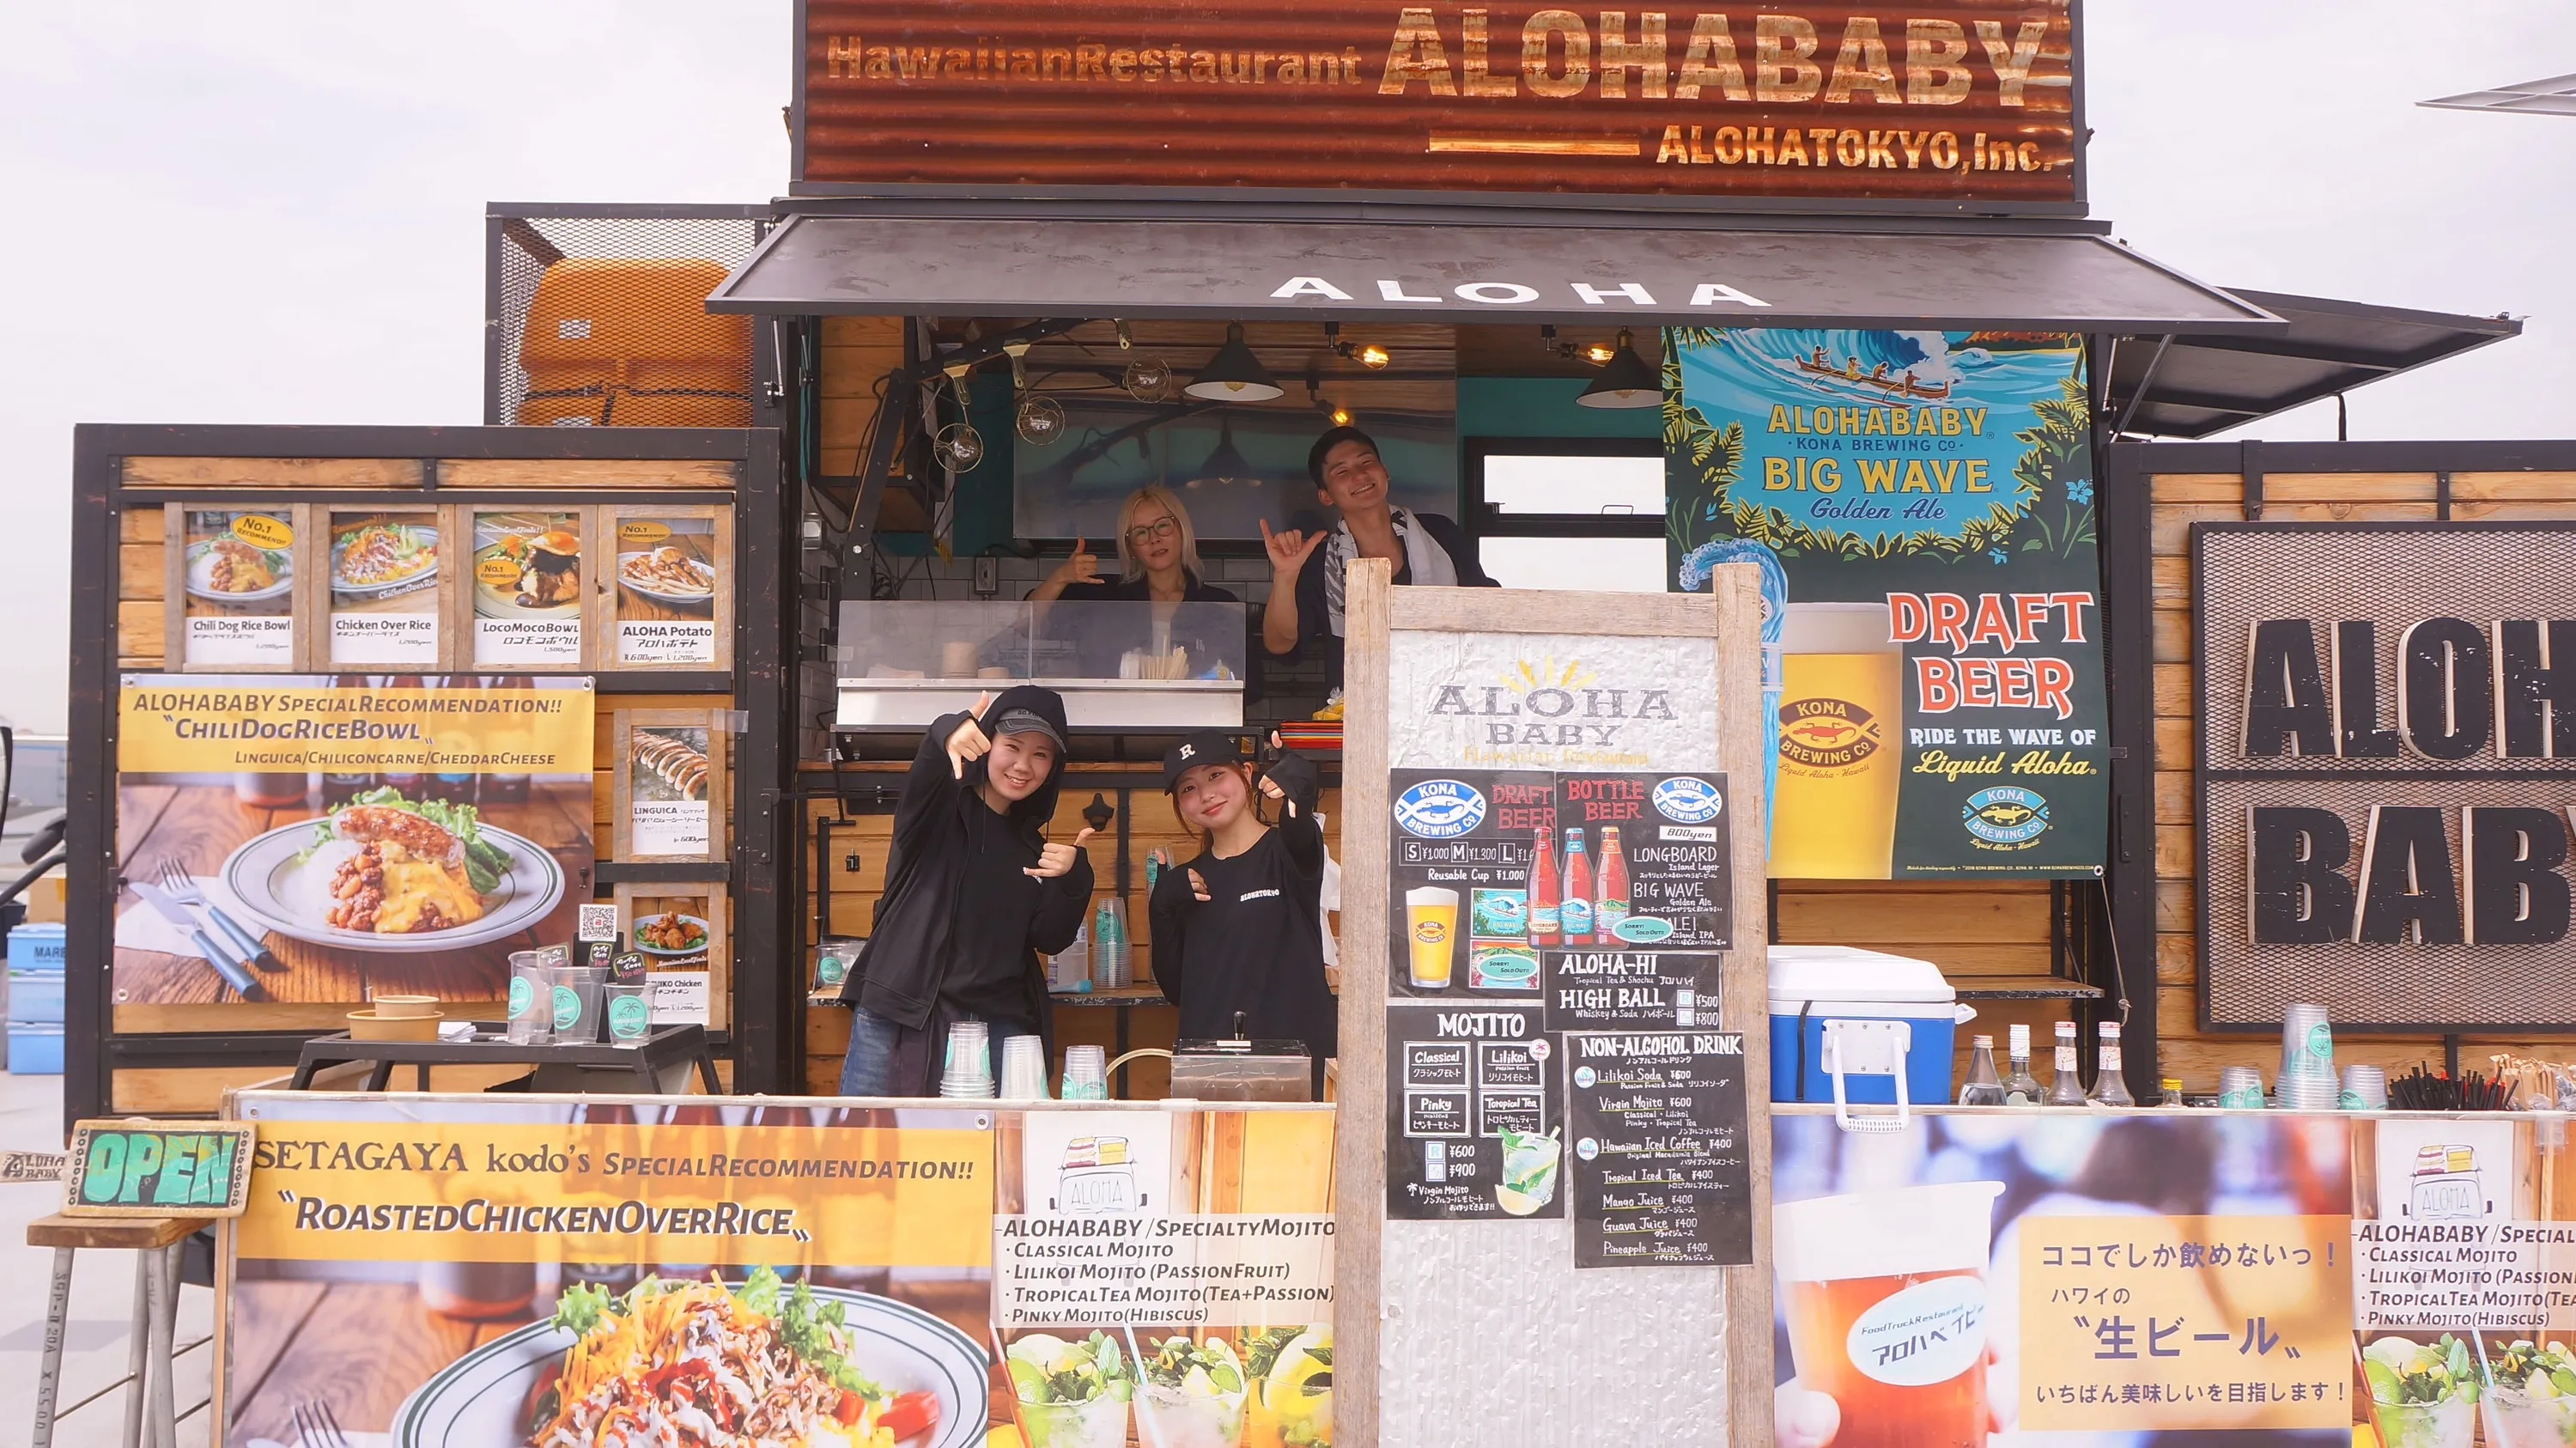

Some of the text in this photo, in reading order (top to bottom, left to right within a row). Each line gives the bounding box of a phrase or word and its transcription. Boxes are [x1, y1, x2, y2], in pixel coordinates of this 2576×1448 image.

[828, 7, 2049, 107] HawaiianRestaurant ALOHABABY
[1269, 277, 1772, 307] ALOHA
[1766, 404, 1988, 437] ALOHABABY
[1796, 437, 1931, 453] KONA BREWING
[1762, 456, 1993, 495] BIG WAVE
[1810, 496, 1947, 520] Golden Ale
[193, 620, 290, 632] Chili Dog Rice Bowl
[336, 619, 431, 630] Chicken Over Rice
[623, 626, 712, 636] ALOHA Potato
[1886, 591, 2096, 656] DRAFT
[1911, 656, 2075, 721] BEER
[133, 694, 274, 712] ALOHABABY
[1428, 684, 1679, 721] ALOHA
[1795, 701, 1847, 717] KONA
[1485, 722, 1622, 746] BABY
[1910, 727, 2097, 748] RIDE THE WAVE OF
[1179, 744, 1196, 760] R
[1780, 739, 1851, 764] BREWING
[1912, 750, 2003, 782] Liquid
[1418, 783, 1457, 798] KONA
[1567, 780, 1645, 800] BOTTLE
[1673, 779, 1703, 793] KONA
[1492, 784, 1552, 806] DRAFT
[1986, 789, 2025, 802] KONA
[1497, 807, 1556, 830] BEER
[1584, 801, 1643, 821] BEER
[1661, 803, 1702, 821] BREWING
[1406, 818, 1462, 836] BREWING
[1667, 828, 1712, 840] 800yen
[1971, 821, 2026, 839] BREWING
[1633, 846, 1717, 862] LONGBOARD
[1428, 868, 1490, 882] Reusable Cup
[1668, 862, 1720, 873] Island Lager
[2246, 805, 2576, 945] BAB
[1633, 882, 1704, 897] BIG WAVE
[1698, 897, 1712, 906] Ale
[1698, 931, 1715, 940] IPA
[1558, 954, 1657, 975] ALOHA-HI
[1574, 976, 1654, 986] Tropical Shochu
[1558, 988, 1666, 1009] HIGH BALL
[1695, 994, 1718, 1007] ¥500
[1575, 1009, 1638, 1020] Whiskey Soda
[1695, 1012, 1718, 1025] ¥800
[1437, 1013, 1526, 1037] MOJITO
[1580, 1035, 1743, 1057] NON-ALCOHOL DRINK
[1414, 1050, 1460, 1064] Classical
[1492, 1049, 1528, 1064] Lilikoi
[1597, 1068, 1663, 1081] Lilikoi Soda
[1420, 1098, 1453, 1111] Pinky
[1522, 1098, 1538, 1109] Tea
[1599, 1095, 1692, 1110] Virgin Mojito ¥600
[1625, 1119, 1683, 1129] Pinky Tropical
[1449, 1145, 1475, 1158] ¥600
[1601, 1136, 1732, 1153] Hawaiian Iced Coffee ¥400
[254, 1140, 465, 1172] SETAGAYA
[83, 1133, 236, 1204] OPEN
[1449, 1164, 1476, 1177] ¥900
[1602, 1169, 1714, 1183] Tropical Iced ¥400
[1071, 1179, 1123, 1206] ALOHA
[1419, 1185, 1469, 1196] Virgin Mojito
[1602, 1192, 1693, 1208] Mango Juice ¥400
[1602, 1216, 1698, 1232] Guava Juice ¥400
[1603, 1241, 1708, 1256] Pineapple Juice ¥400
[2051, 1286, 2131, 1305] ハワイの
